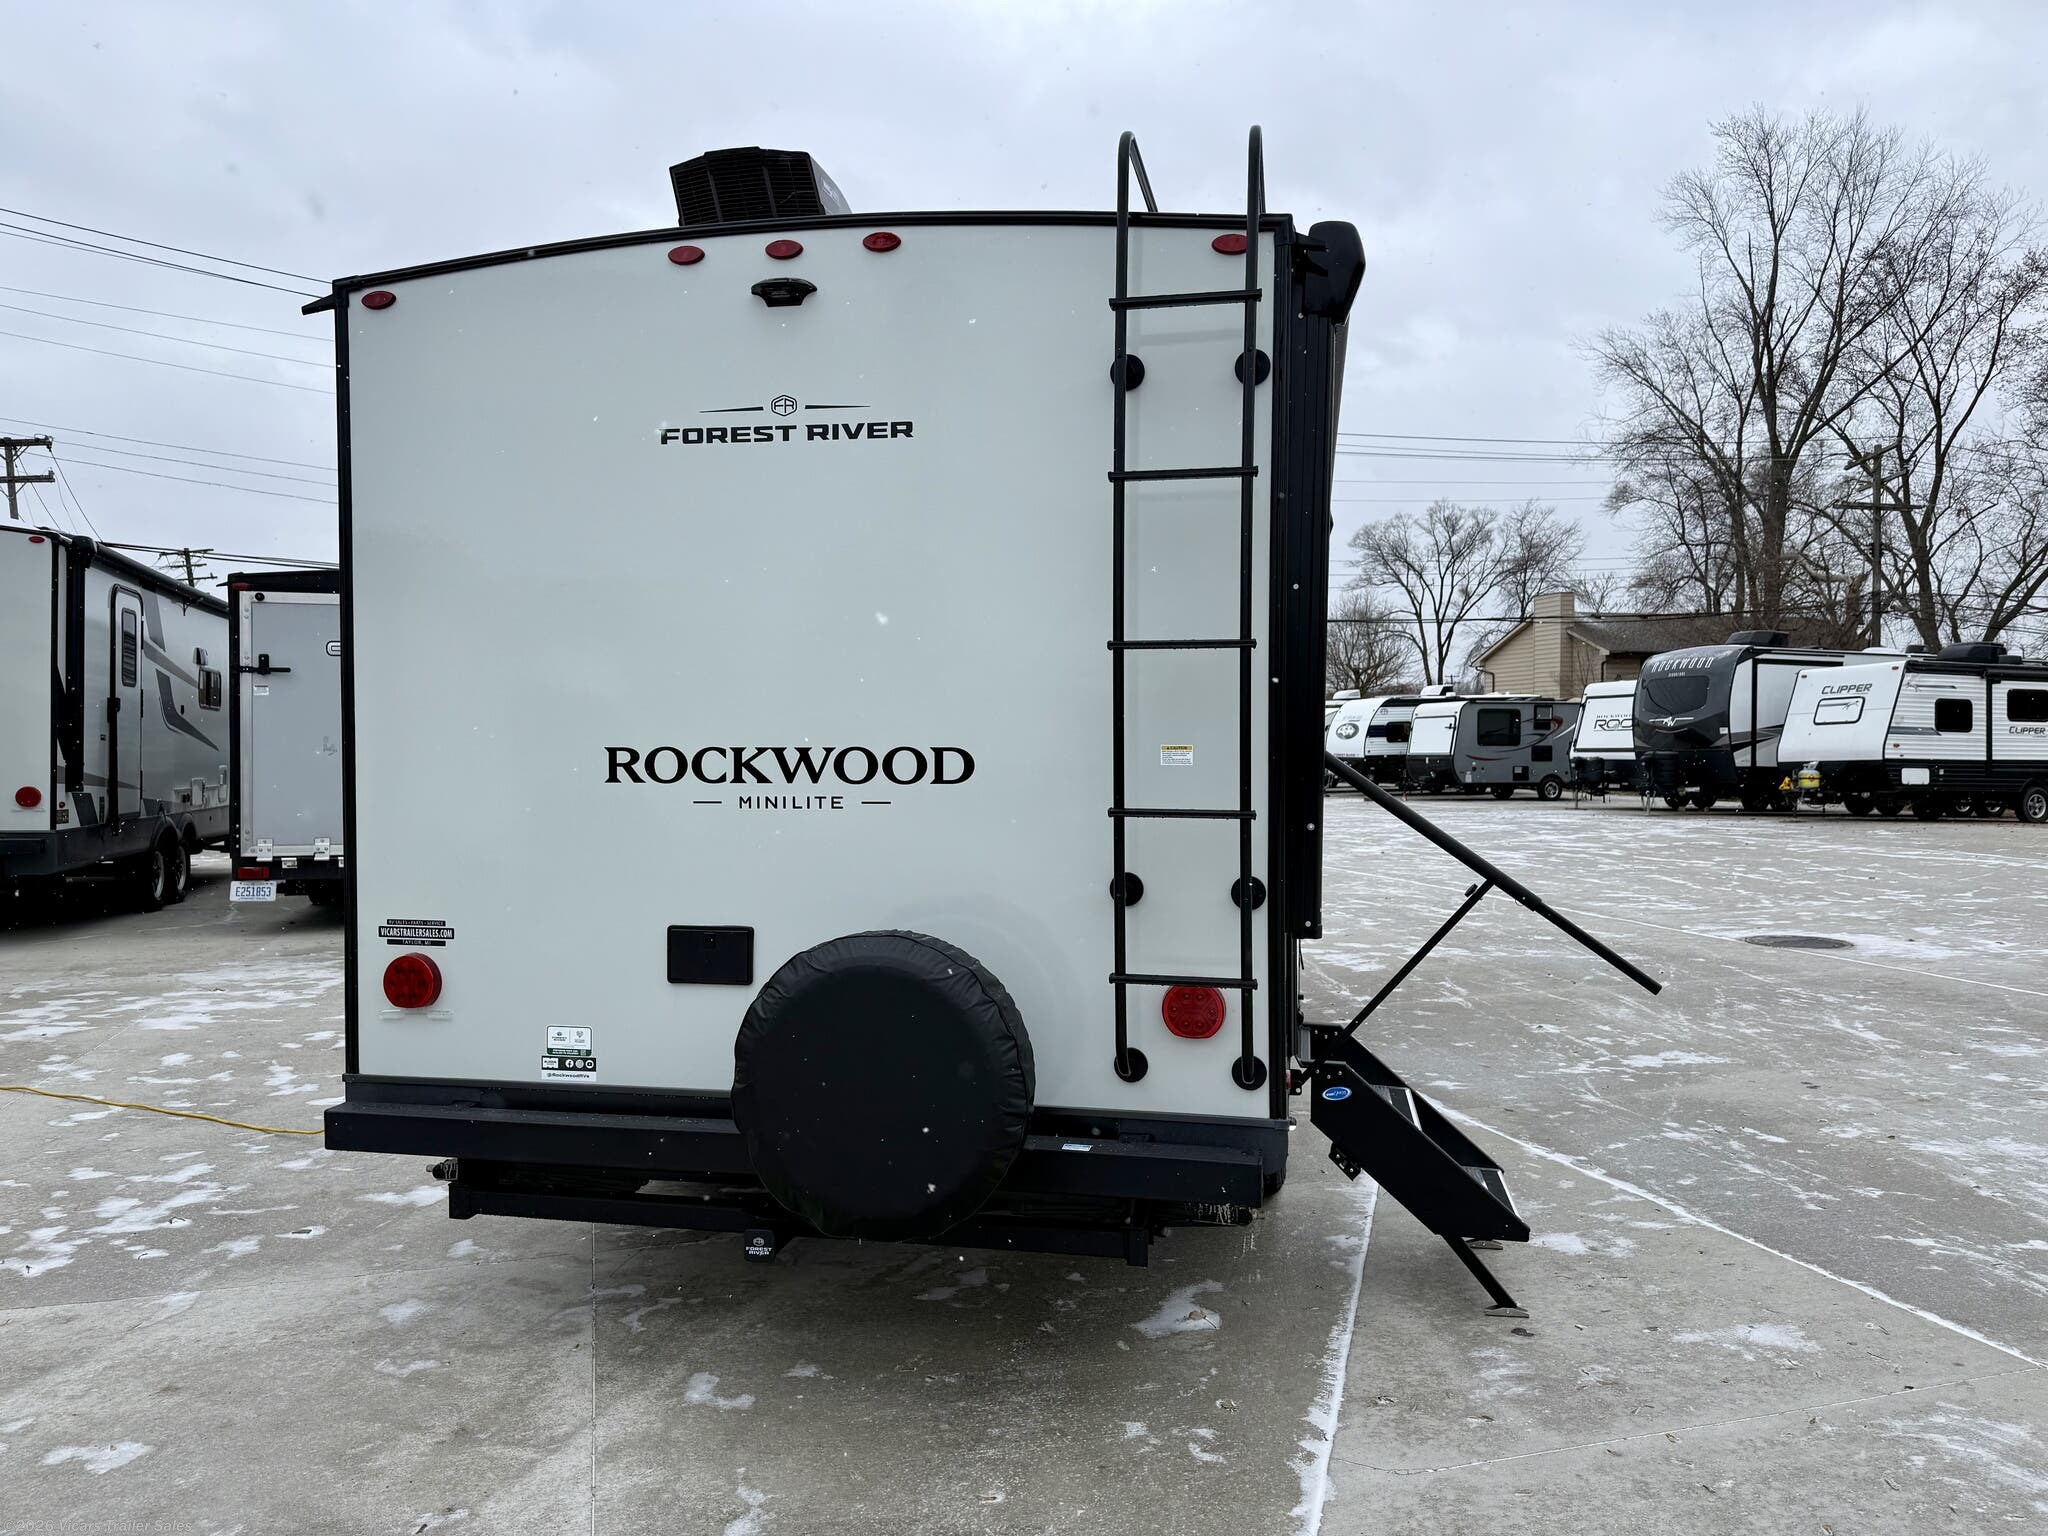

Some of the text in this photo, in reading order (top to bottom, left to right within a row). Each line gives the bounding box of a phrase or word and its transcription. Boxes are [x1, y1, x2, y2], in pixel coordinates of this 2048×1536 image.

[659, 421, 914, 445] FOREST RIVER
[1821, 683, 1872, 694] CLIPPER
[2008, 726, 2046, 735] CLIPPER
[603, 746, 976, 785] ROCKWOOD
[738, 796, 844, 809] MINILITE
[380, 927, 453, 938] VICARSTRAILERSALES.COM
